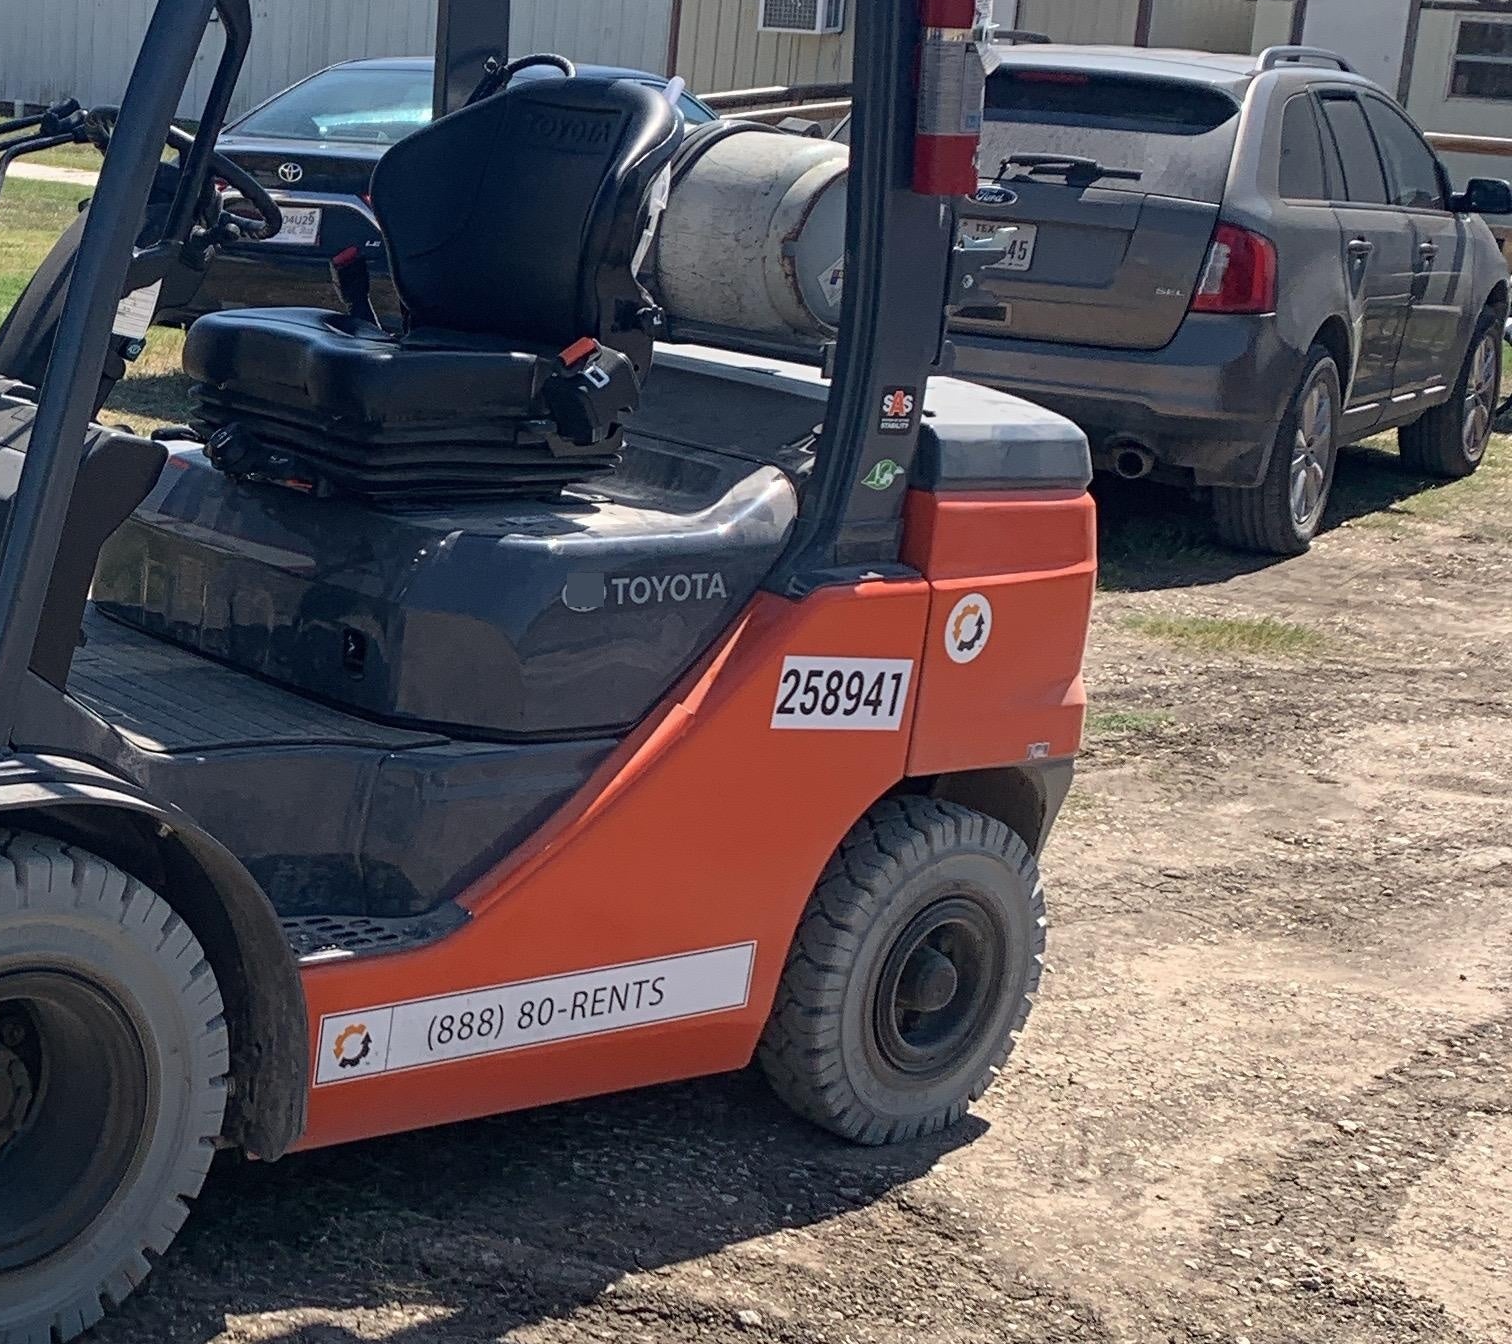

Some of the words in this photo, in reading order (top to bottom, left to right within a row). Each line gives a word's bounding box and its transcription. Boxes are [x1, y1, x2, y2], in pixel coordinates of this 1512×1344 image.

[975, 191, 1004, 203] Ford
[882, 390, 914, 416] SAS
[611, 571, 728, 605] TOYOTA
[775, 668, 904, 717] 258941
[426, 1001, 506, 1051] (888)
[516, 976, 667, 1030] 80-RENTS
